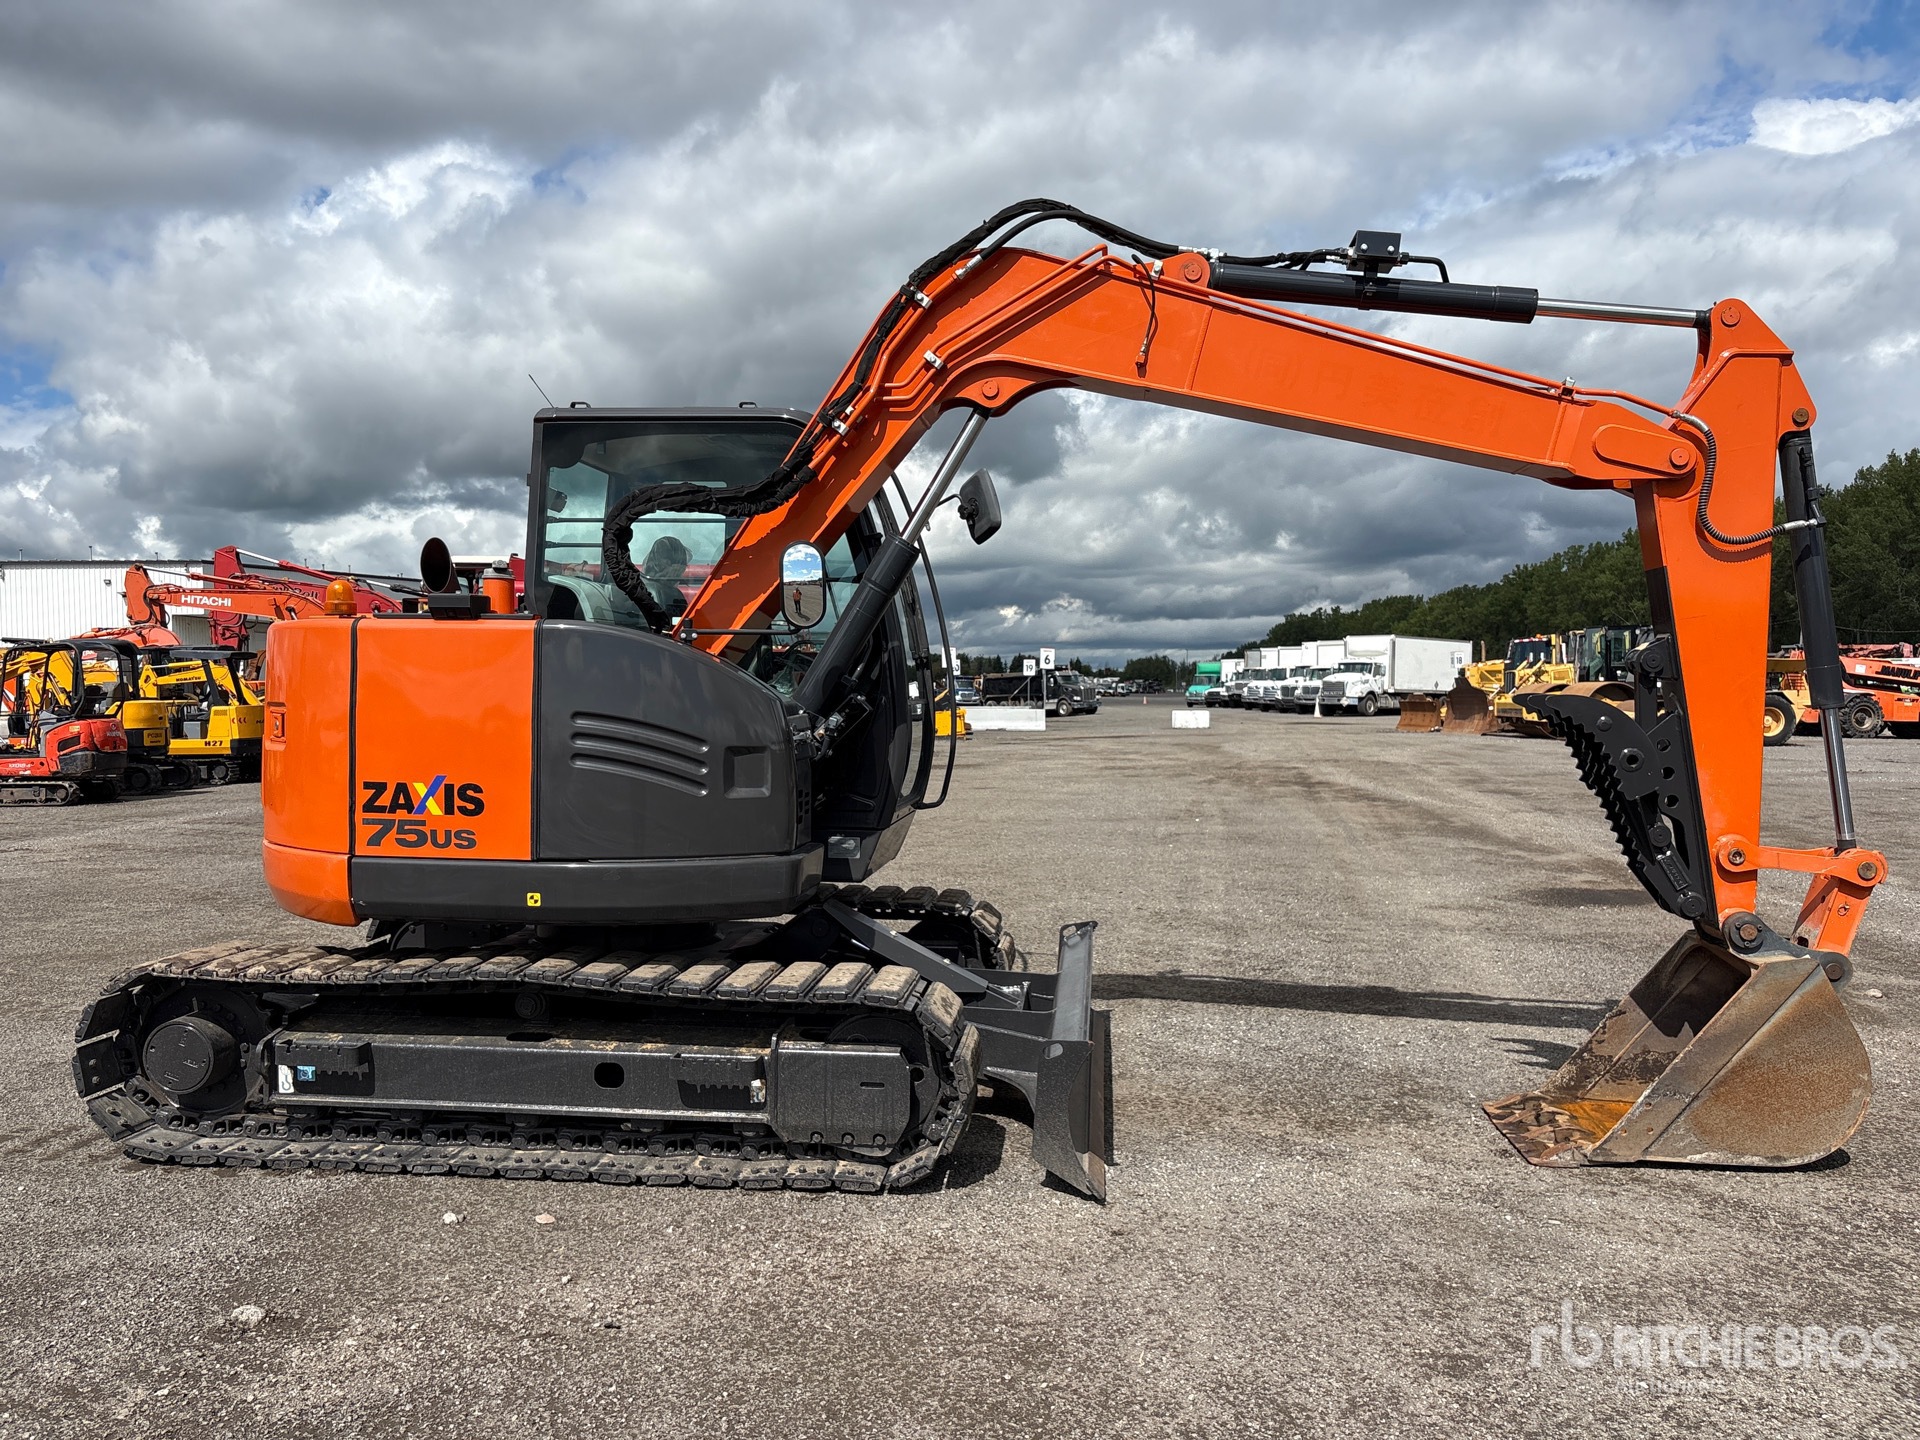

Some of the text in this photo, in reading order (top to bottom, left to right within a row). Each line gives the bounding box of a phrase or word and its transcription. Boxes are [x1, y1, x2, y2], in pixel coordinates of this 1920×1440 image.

[181, 594, 232, 607] HITACHI
[1044, 654, 1051, 665] 6
[1456, 656, 1463, 665] 18
[1025, 664, 1034, 672] 19
[362, 775, 485, 817] ZAXIS
